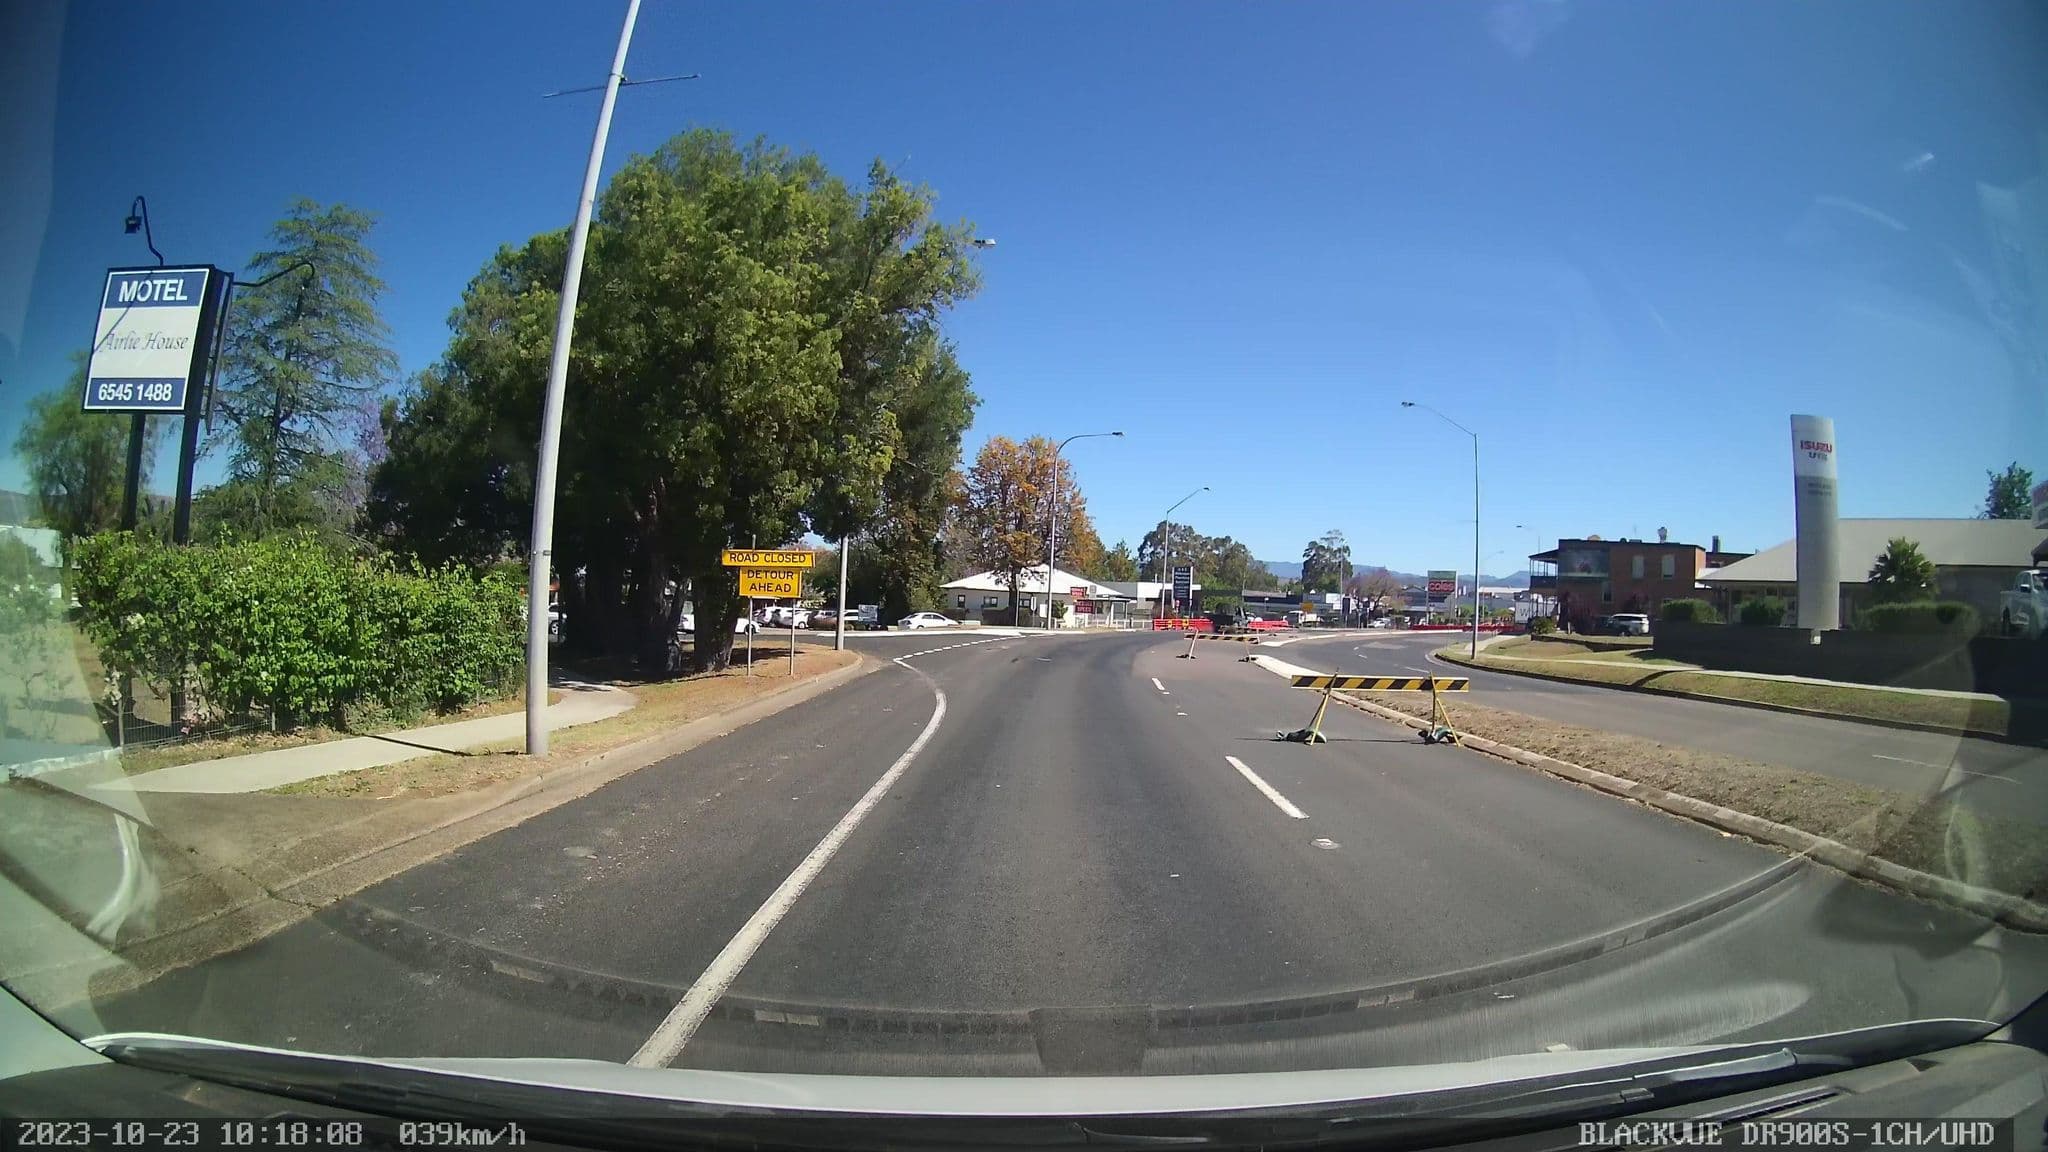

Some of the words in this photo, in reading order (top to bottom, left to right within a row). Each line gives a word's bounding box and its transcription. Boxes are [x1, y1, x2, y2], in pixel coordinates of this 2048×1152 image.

[118, 279, 188, 302] MOTEL
[100, 331, 140, 352] Airlie
[142, 331, 189, 350] House
[98, 384, 132, 401] 6545
[137, 383, 172, 401] 1488
[1800, 440, 1833, 453] ISUZU
[729, 553, 760, 563] ROAD
[764, 553, 806, 563] CLOSED
[747, 569, 794, 580] DETOUR
[749, 582, 792, 593] AHEAD
